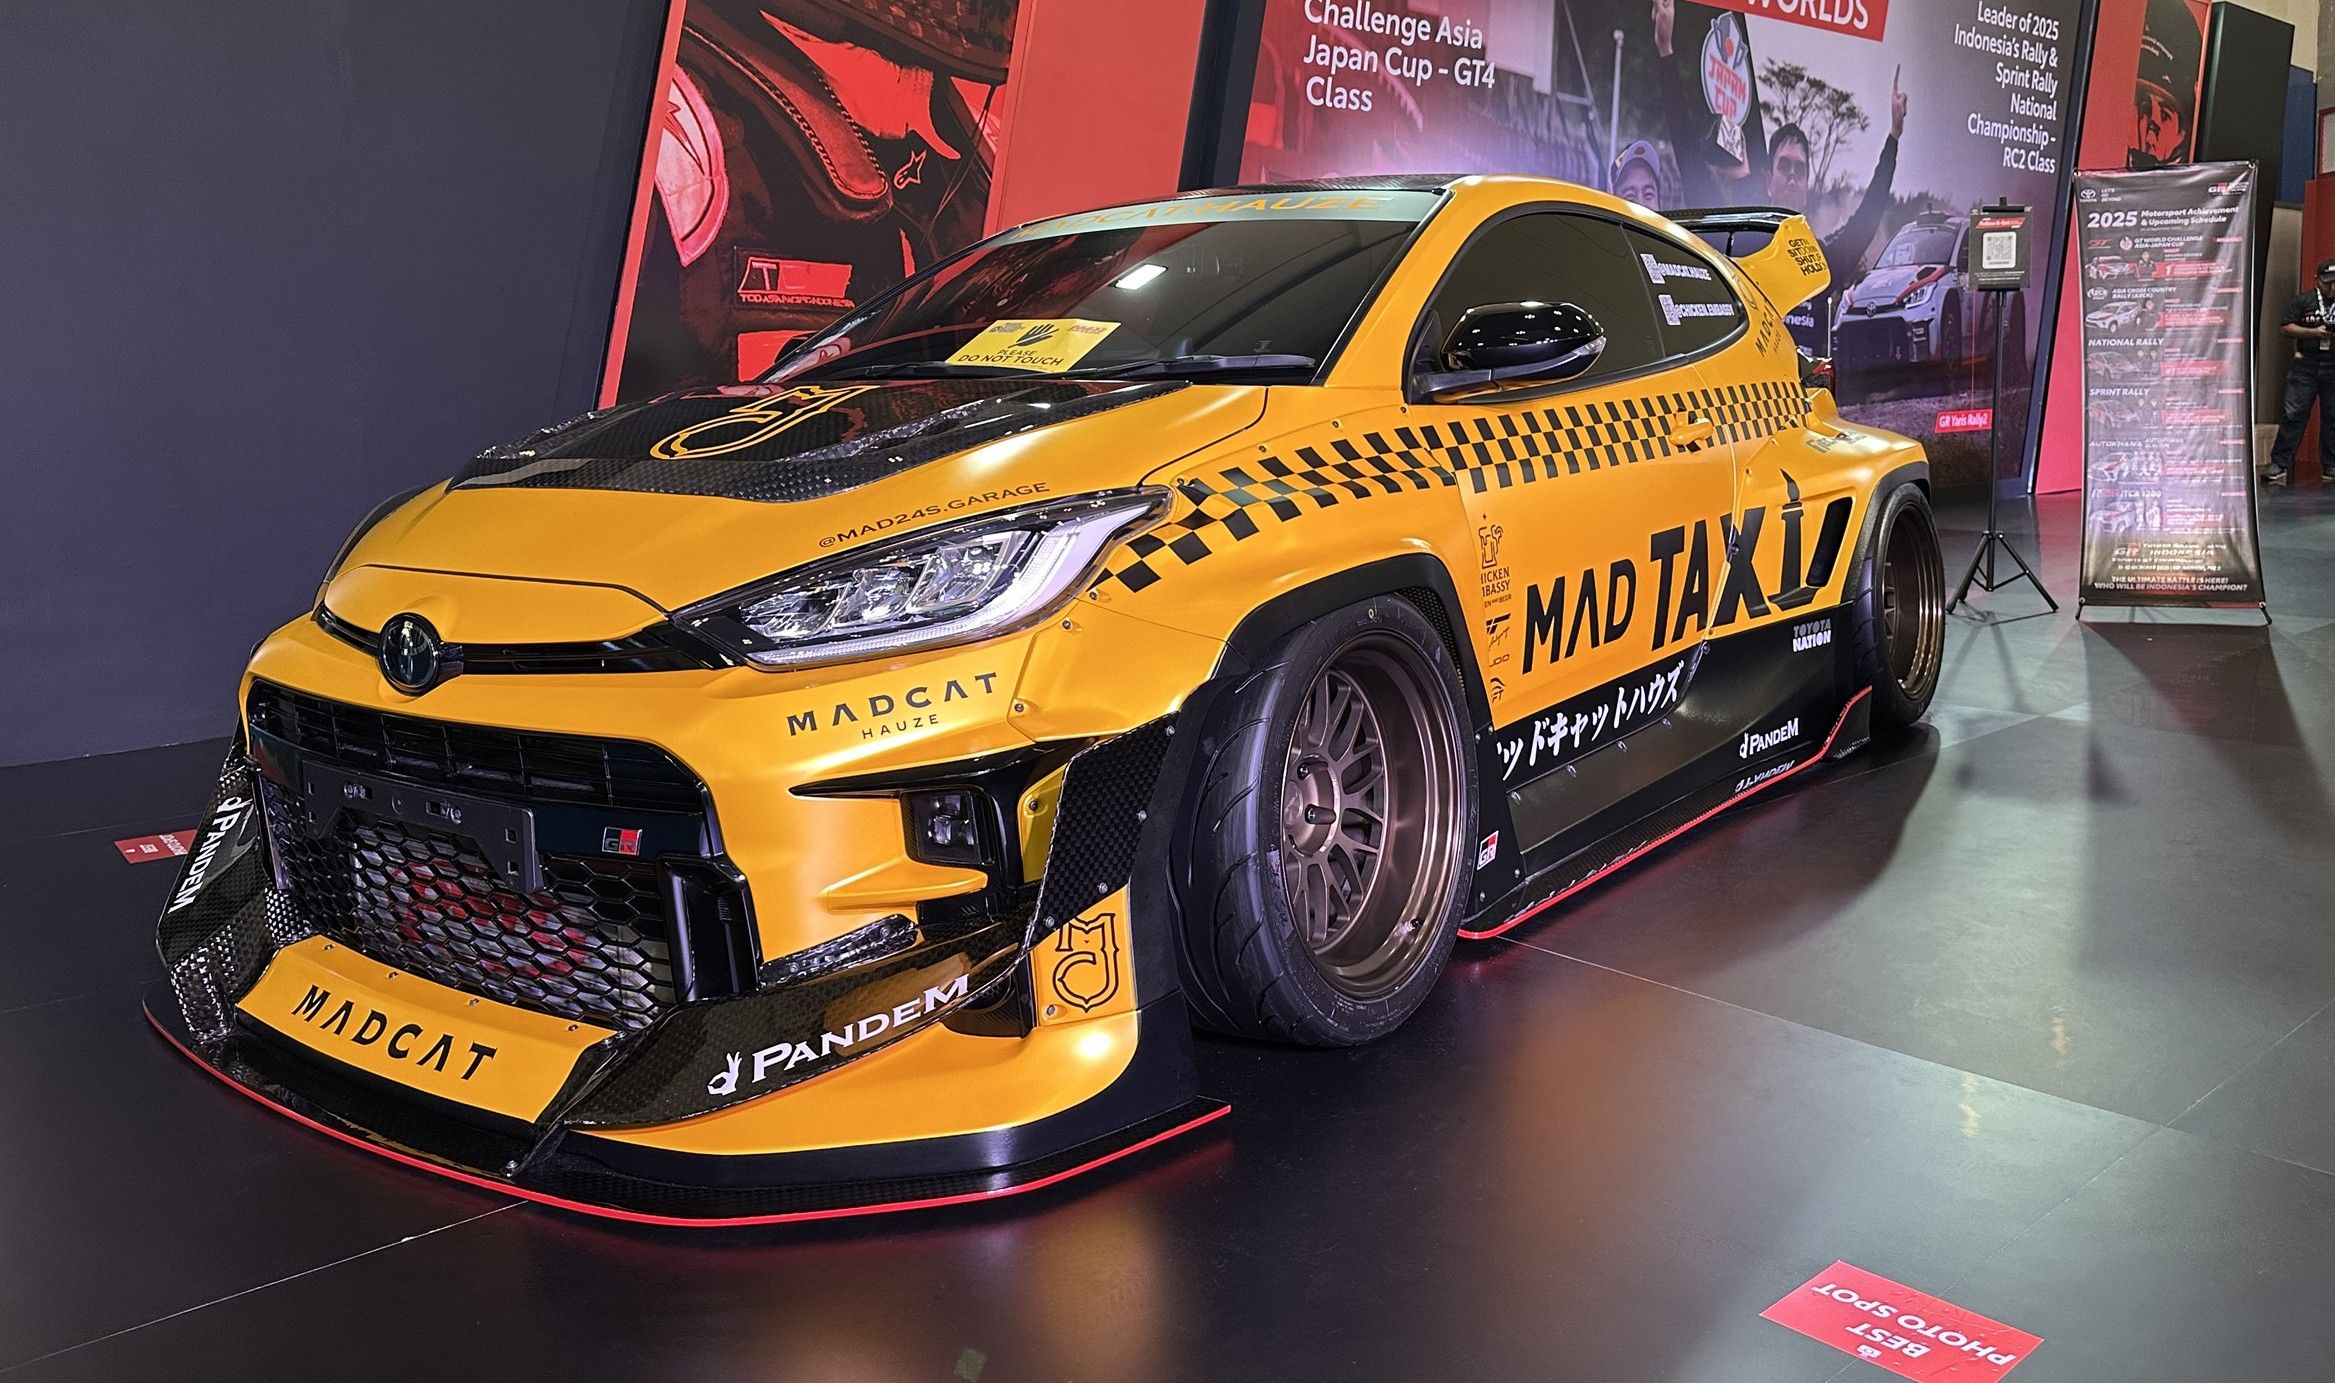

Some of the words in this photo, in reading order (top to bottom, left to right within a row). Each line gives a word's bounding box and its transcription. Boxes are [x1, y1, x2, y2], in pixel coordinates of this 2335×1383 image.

[1303, 0, 1431, 46] Challenge
[1434, 16, 1484, 49] Asia
[1747, 0, 1869, 30] ORLDS
[1976, 1, 2020, 33] Leader
[2020, 13, 2031, 34] of
[2032, 15, 2059, 41] 2025
[1303, 34, 1379, 75] Japan
[1384, 46, 1433, 87] Cup
[1453, 57, 1496, 90] GT4
[1954, 24, 2019, 59] Indonesia's
[2020, 37, 2048, 67] Rally
[2048, 46, 2059, 68] &
[1305, 75, 1374, 113] Class
[1707, 53, 1747, 102] JAPAN
[1995, 62, 2030, 91] Sprint
[2031, 68, 2059, 99] Rally
[1713, 85, 1738, 118] CUP
[2010, 93, 2057, 121] National
[1967, 112, 2049, 147] Championship
[2002, 147, 2026, 170] RC2
[2027, 149, 2055, 174] Class
[2087, 210, 2138, 229] 2025
[2140, 208, 2187, 218] Motorsport
[2187, 206, 2239, 216] Achievement
[2148, 216, 2189, 228] Upcoming
[2190, 215, 2227, 225] Schedule
[1795, 253, 1816, 266] SHUT
[1800, 262, 1822, 276] HOLD
[2088, 338, 2134, 347] NATIONAL
[2135, 337, 2165, 346] RALLY
[957, 354, 980, 362] DO
[981, 355, 1012, 363] NOT
[1014, 356, 1065, 366] TOUCH
[2089, 388, 2122, 396] SPRINT
[2122, 387, 2150, 396] RALLY
[1938, 416, 1950, 428] GR
[1950, 416, 1967, 428] Yaris
[1967, 414, 1989, 429] Rally2
[818, 482, 1051, 549] @MAD24S.GARAGE
[1521, 558, 1638, 675] MAD
[1650, 468, 1823, 652] TAXI
[2094, 582, 2115, 590] WHO
[2197, 583, 2248, 591] CHAMPION?
[1792, 629, 1832, 653] NATION
[1793, 618, 1832, 638] TOYOTA
[786, 672, 998, 736] MADCAT
[1496, 659, 1685, 782] ッドキャットハウズ
[861, 713, 939, 740] HAUZE
[1749, 717, 1799, 756] PANDEM
[167, 810, 241, 914] PANDEM
[291, 984, 497, 1081] MADCAT
[751, 972, 971, 1084] PANDEM
[1809, 1283, 1899, 1319] SPOT
[1844, 1322, 1933, 1360] BEST
[1896, 1314, 2018, 1366] PHOTO
